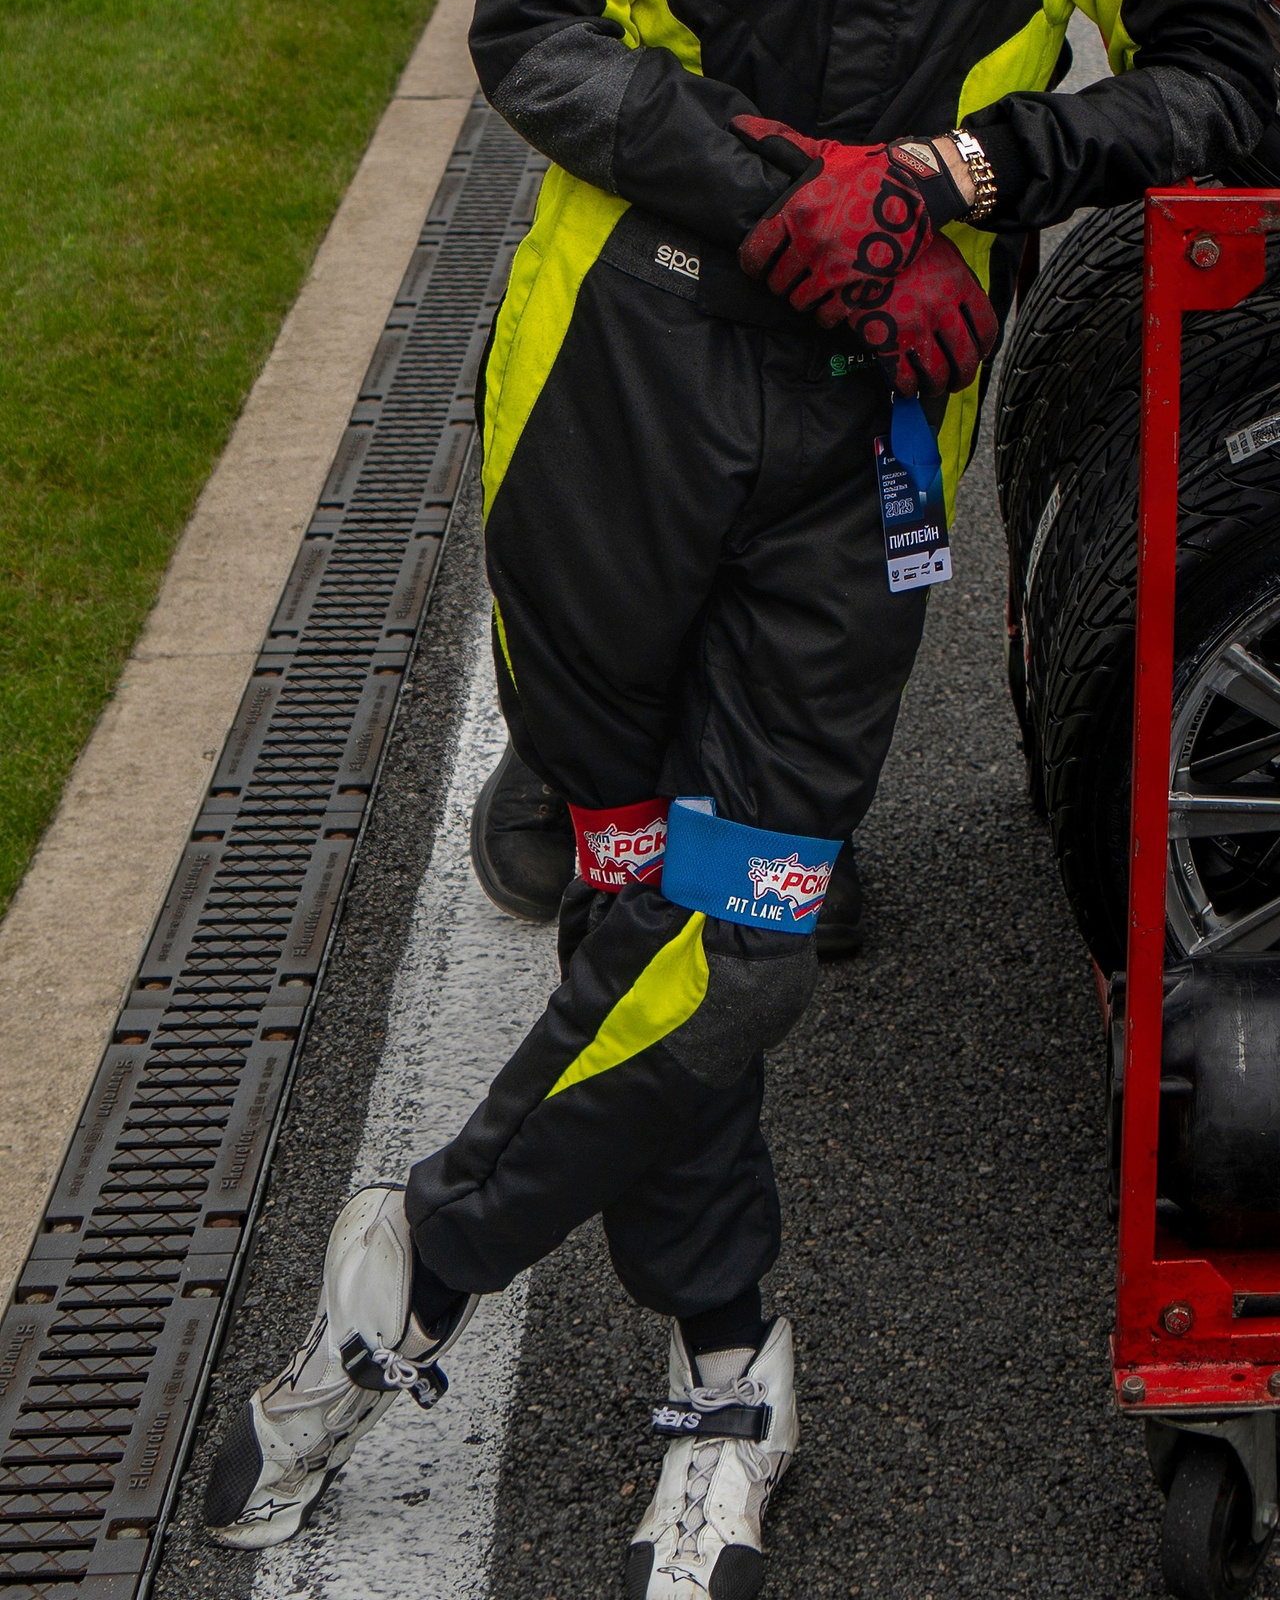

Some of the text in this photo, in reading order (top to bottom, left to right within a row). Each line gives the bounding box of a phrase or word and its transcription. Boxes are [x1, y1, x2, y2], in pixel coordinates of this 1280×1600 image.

[655, 244, 699, 280] spa
[885, 498, 915, 518] 2025
[889, 525, 940, 550] ПИТЛЕЙН
[584, 830, 610, 844] СМП
[748, 856, 787, 874] СМП
[602, 871, 628, 885] LANE
[726, 896, 784, 921] PIT LANE
